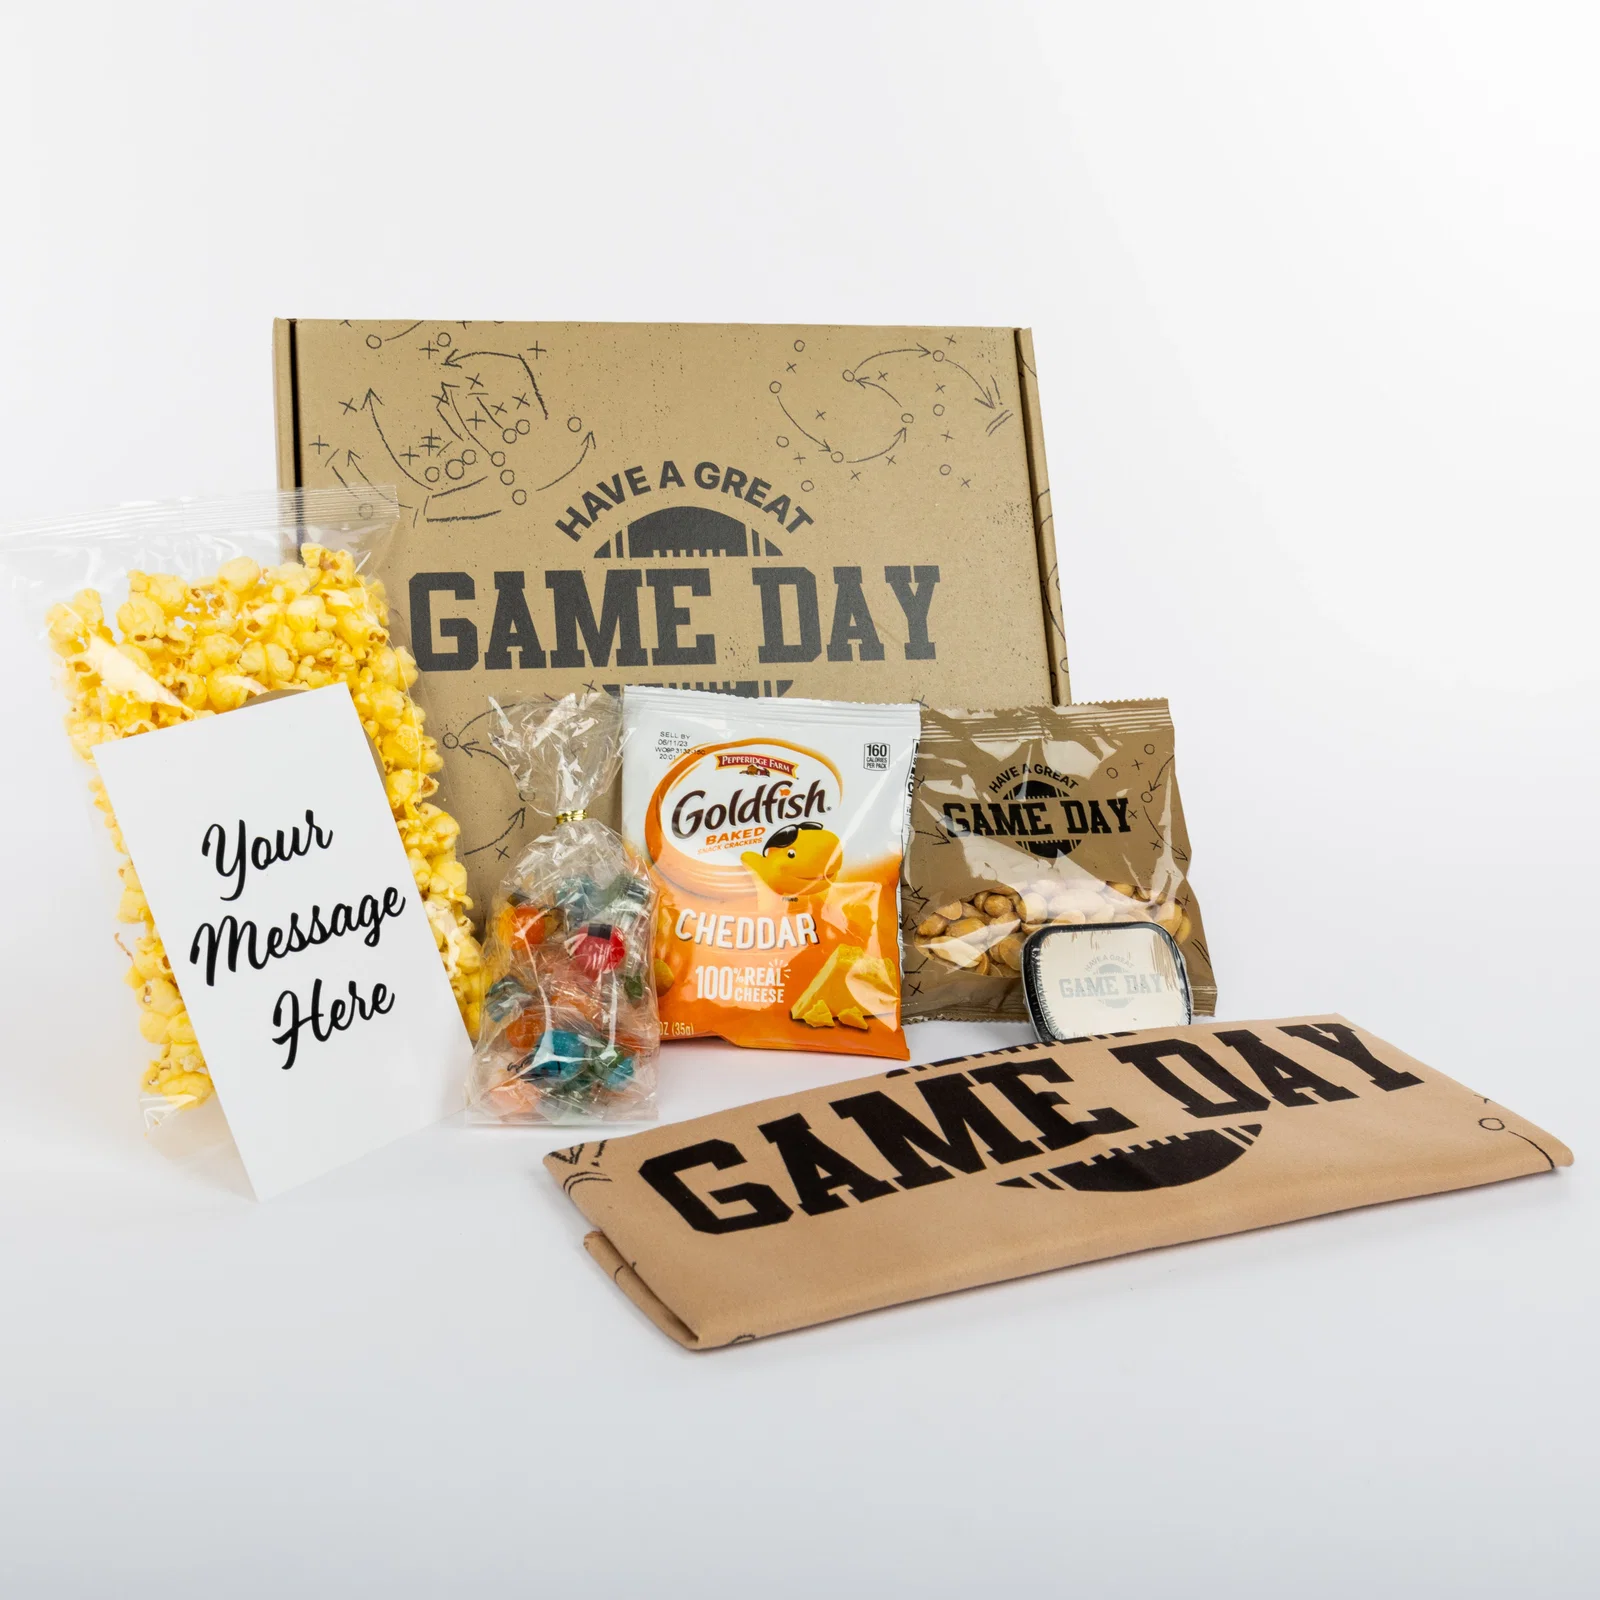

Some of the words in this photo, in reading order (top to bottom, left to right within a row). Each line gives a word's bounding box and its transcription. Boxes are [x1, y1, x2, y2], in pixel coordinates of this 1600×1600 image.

[554, 465, 652, 543] HAVE
[659, 460, 686, 489] A
[694, 461, 815, 534] GREAT
[408, 567, 717, 672] GAME
[752, 564, 941, 663] DAY
[722, 756, 768, 766] PEPPERIDGE
[769, 760, 791, 773] FARM
[867, 744, 887, 757] 160
[989, 766, 1020, 794] HAVE
[1022, 763, 1032, 774] A
[1033, 763, 1079, 790] GREAT
[671, 780, 826, 839] Goldfish
[942, 802, 1053, 838] GAME
[1059, 797, 1131, 833] DAY
[697, 844, 721, 854] SNACK
[724, 838, 763, 849] CRACKERS
[705, 827, 766, 846] BAKED
[201, 809, 333, 901] Your
[189, 886, 406, 987] Message
[674, 908, 820, 950] CHEDDAR
[745, 966, 785, 987] REAL
[1085, 955, 1102, 973] HAVE
[1109, 954, 1135, 968] GREAT
[735, 987, 784, 1003] CHEESE
[1059, 976, 1119, 999] GAME
[1124, 973, 1163, 995] DAY
[271, 978, 395, 1070] Here
[638, 1057, 1139, 1235] GAME
[1108, 1023, 1425, 1119] DAY
